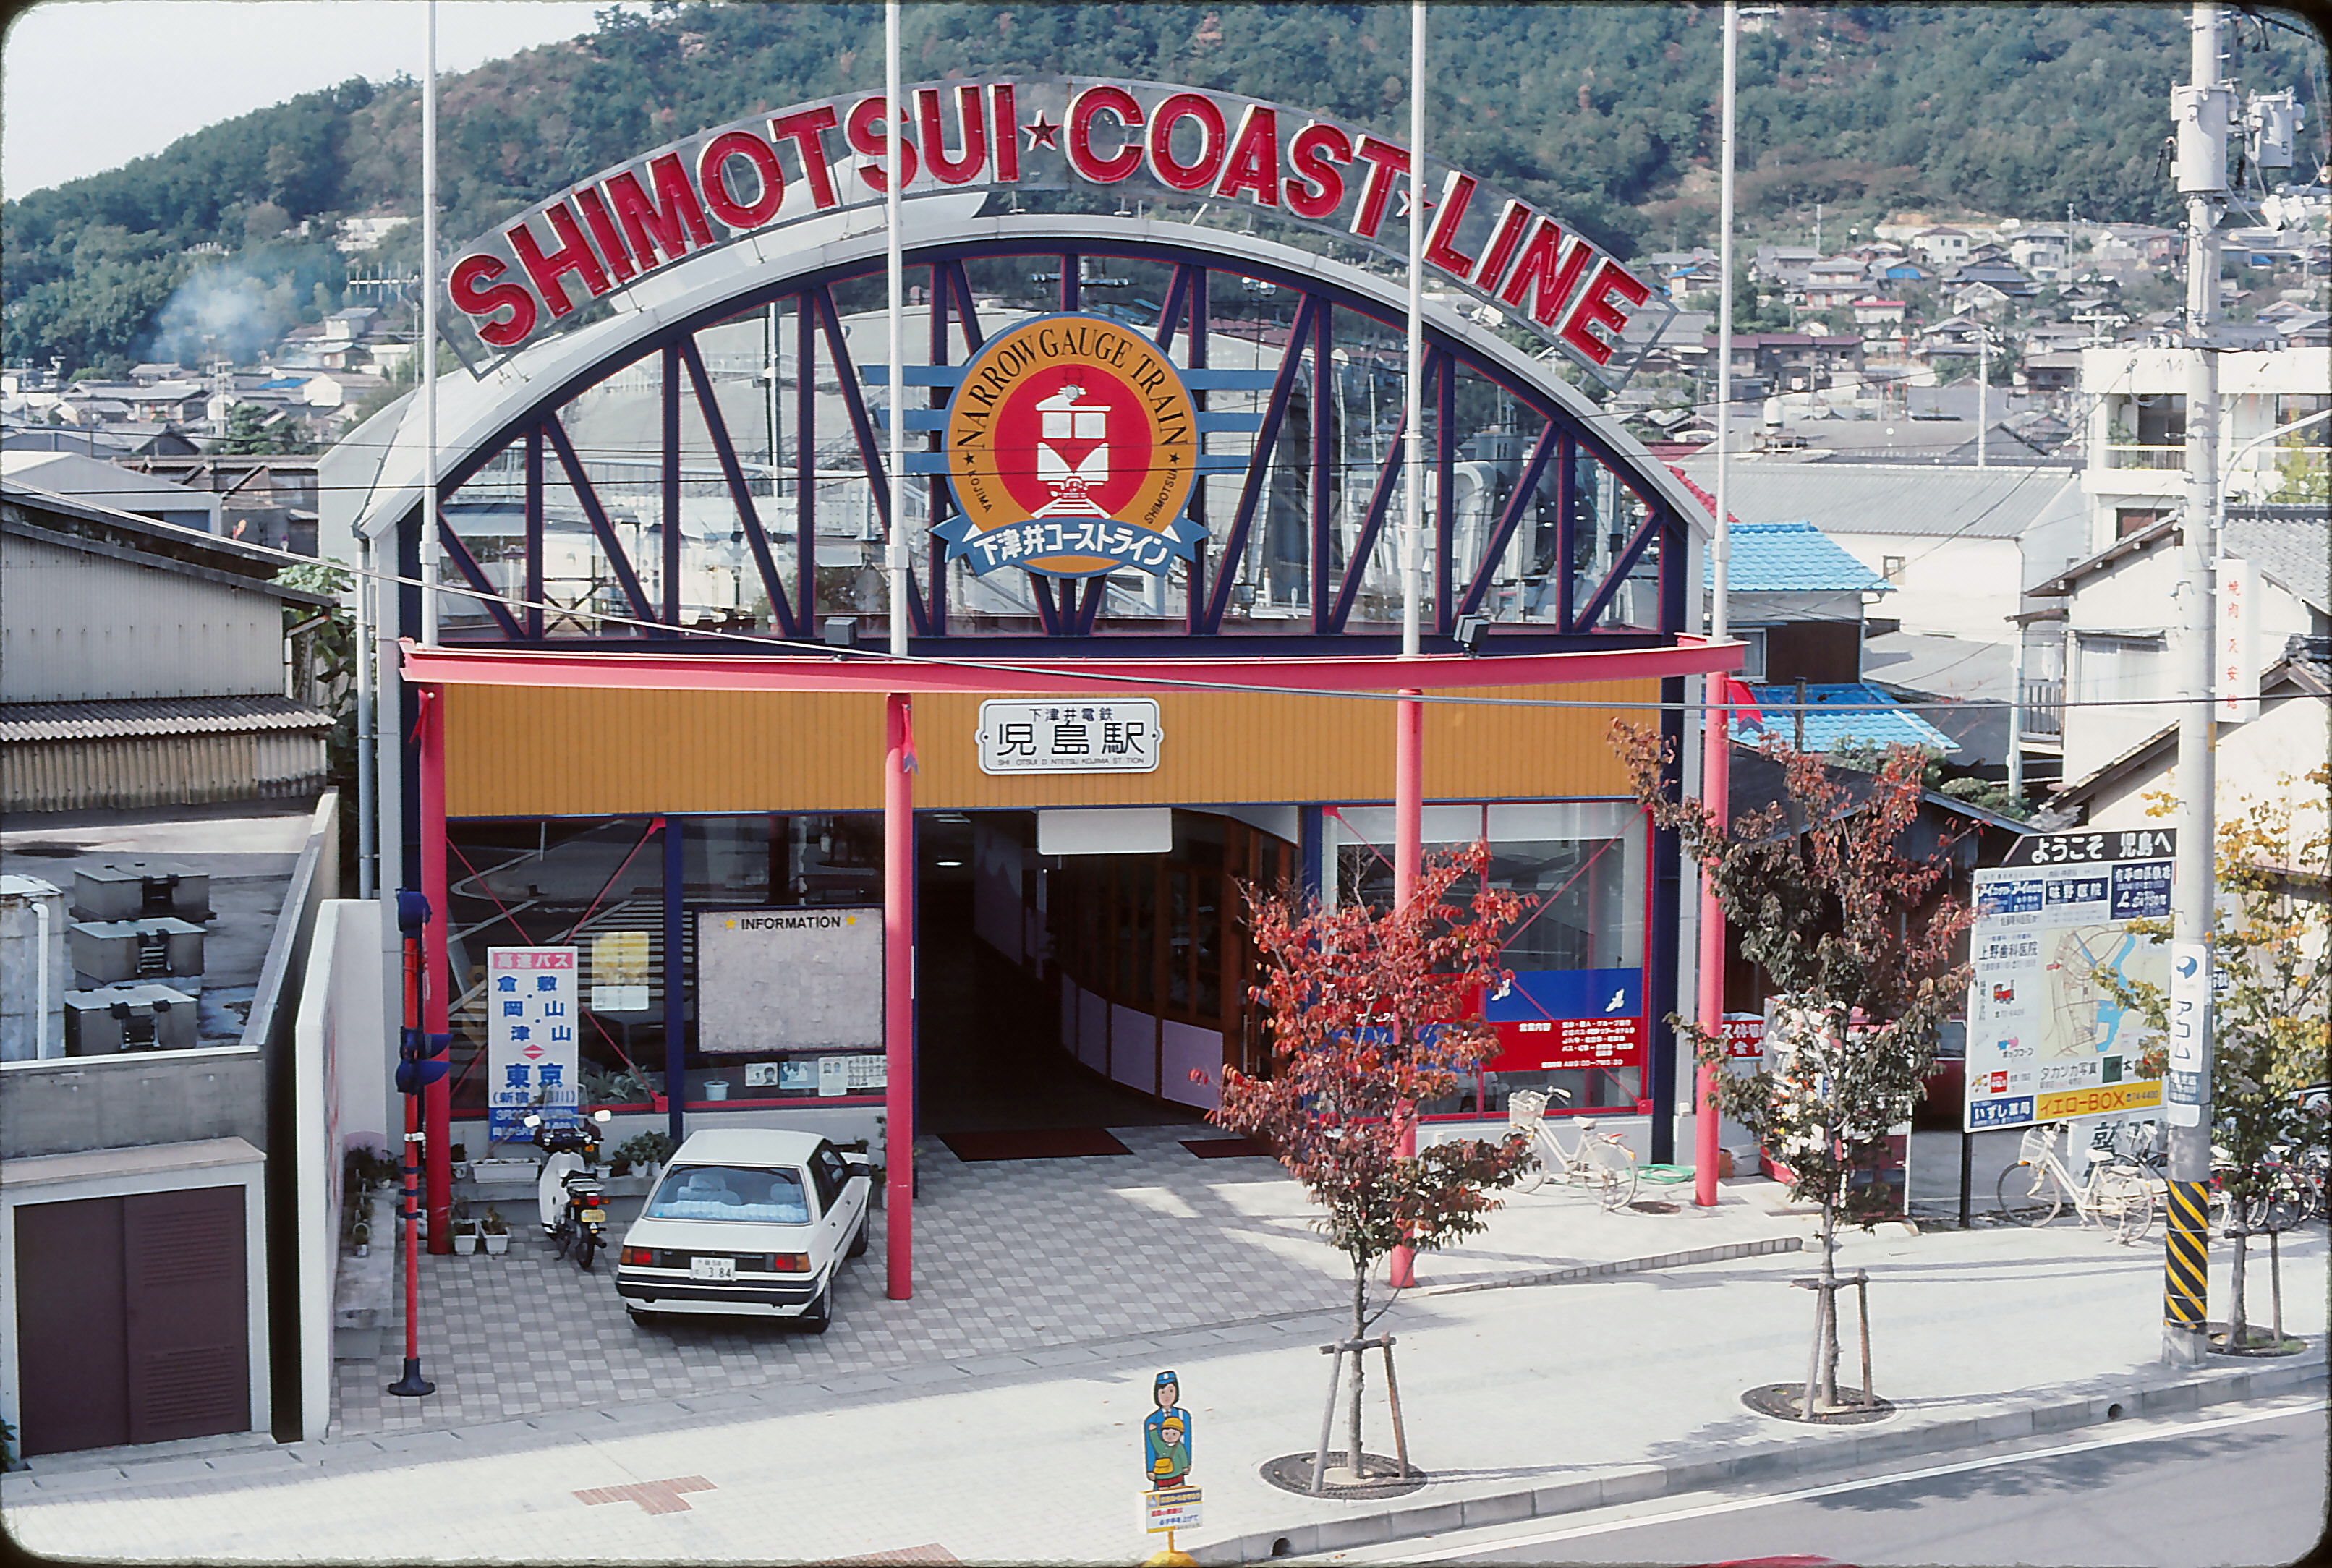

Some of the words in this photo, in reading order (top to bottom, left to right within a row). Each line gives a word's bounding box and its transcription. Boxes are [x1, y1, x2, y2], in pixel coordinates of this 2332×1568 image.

[448, 83, 1021, 348] SHIMOTSUI
[1063, 84, 1414, 239] COAST
[1423, 169, 1652, 367] LINE
[956, 334, 1037, 449] NARROW
[1039, 325, 1133, 369] GAUGE
[1129, 352, 1188, 446] TRAIN
[1143, 468, 1182, 525] SHIMOTSUI
[972, 522, 1168, 567] 下津井コーストライン
[1028, 707, 1114, 723] 下津井電鉄
[996, 720, 1145, 757] 児島駅
[2031, 835, 2105, 864] ようこそ
[2120, 831, 2173, 858] 児島へ
[741, 916, 841, 930] INFORMATION
[1978, 941, 2038, 960] 上野歯科医院
[503, 1000, 565, 1017] 岡山
[510, 1024, 571, 1041] 津山
[505, 1062, 564, 1089] 東京
[2039, 1091, 2126, 1117] イエローBOX
